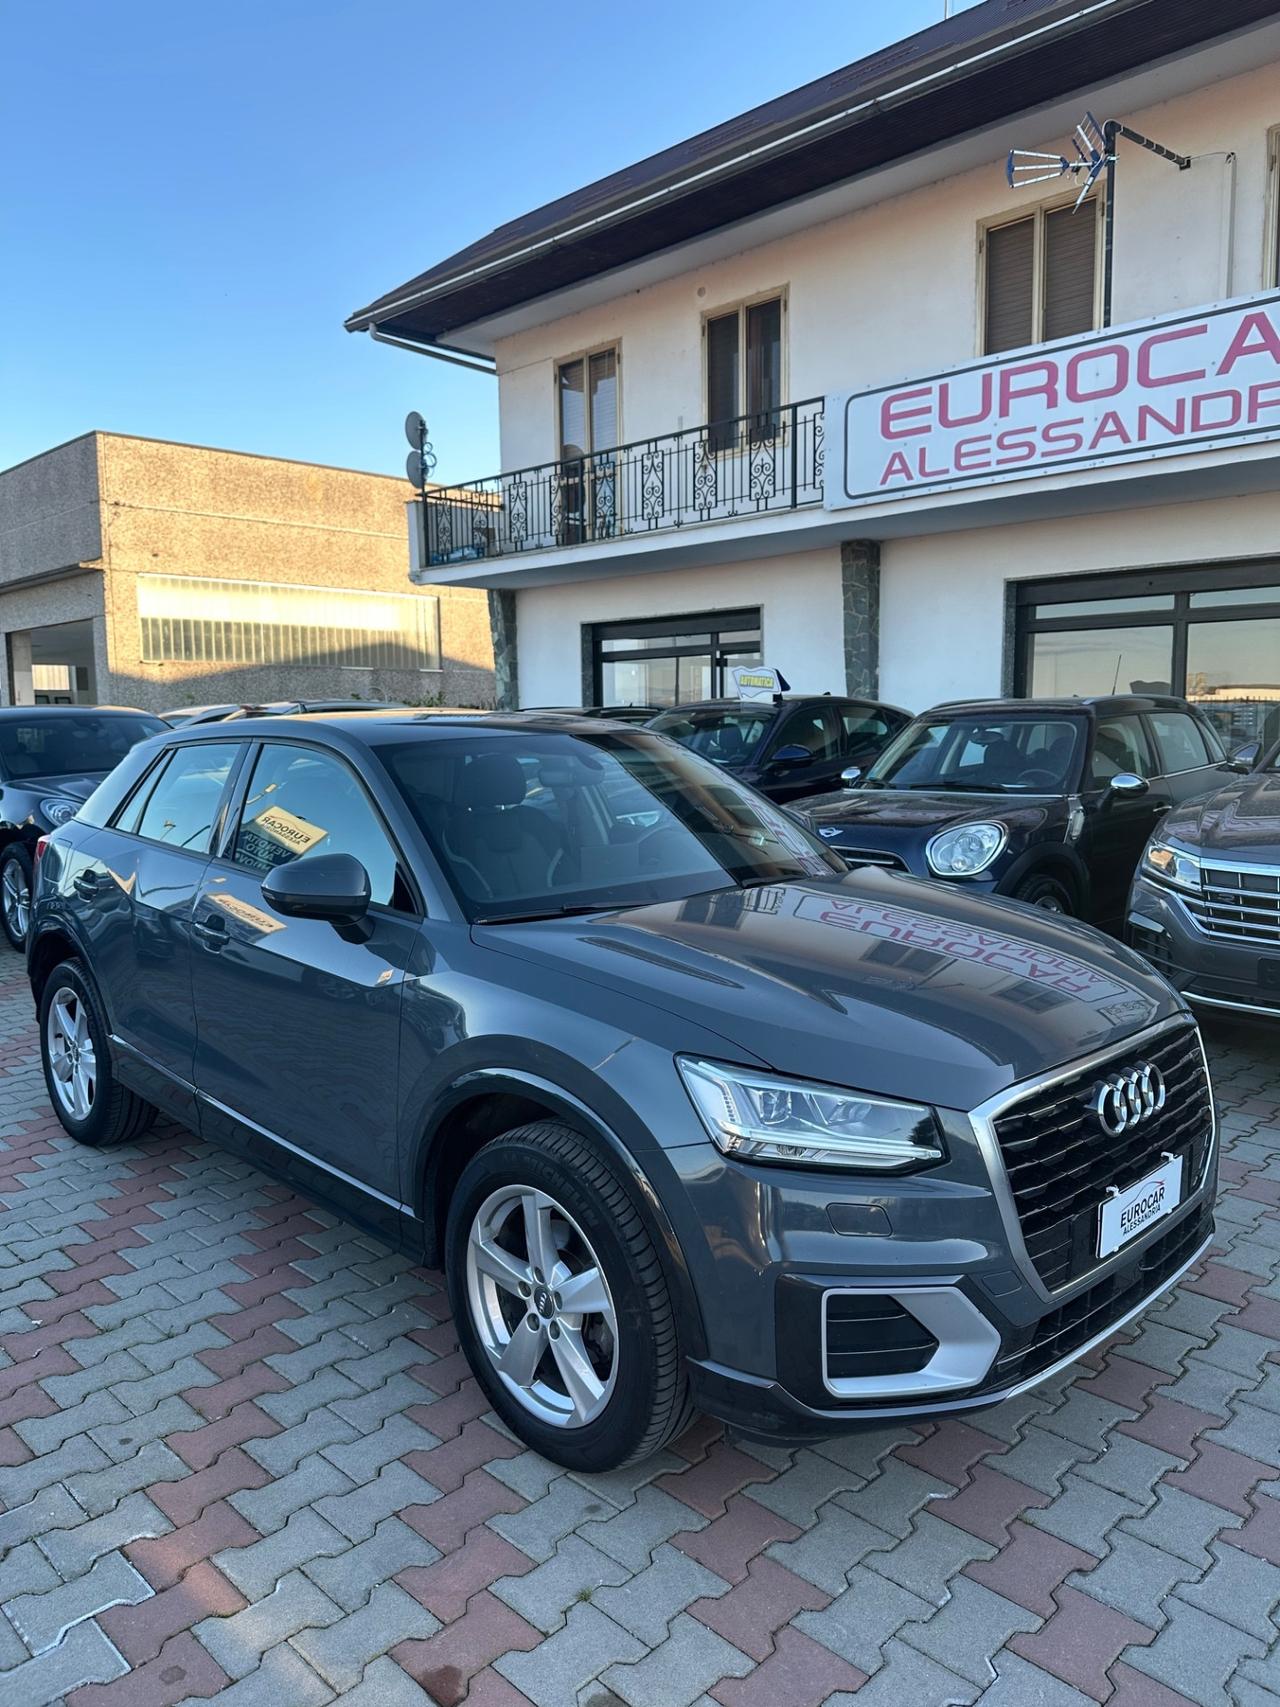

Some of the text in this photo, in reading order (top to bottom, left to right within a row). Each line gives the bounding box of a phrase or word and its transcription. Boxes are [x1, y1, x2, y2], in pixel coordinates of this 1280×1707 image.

[880, 311, 1280, 440] EUROCA
[1120, 1187, 1165, 1228] EUROCAR
[1123, 1204, 1161, 1235] ALESSANDRIA
